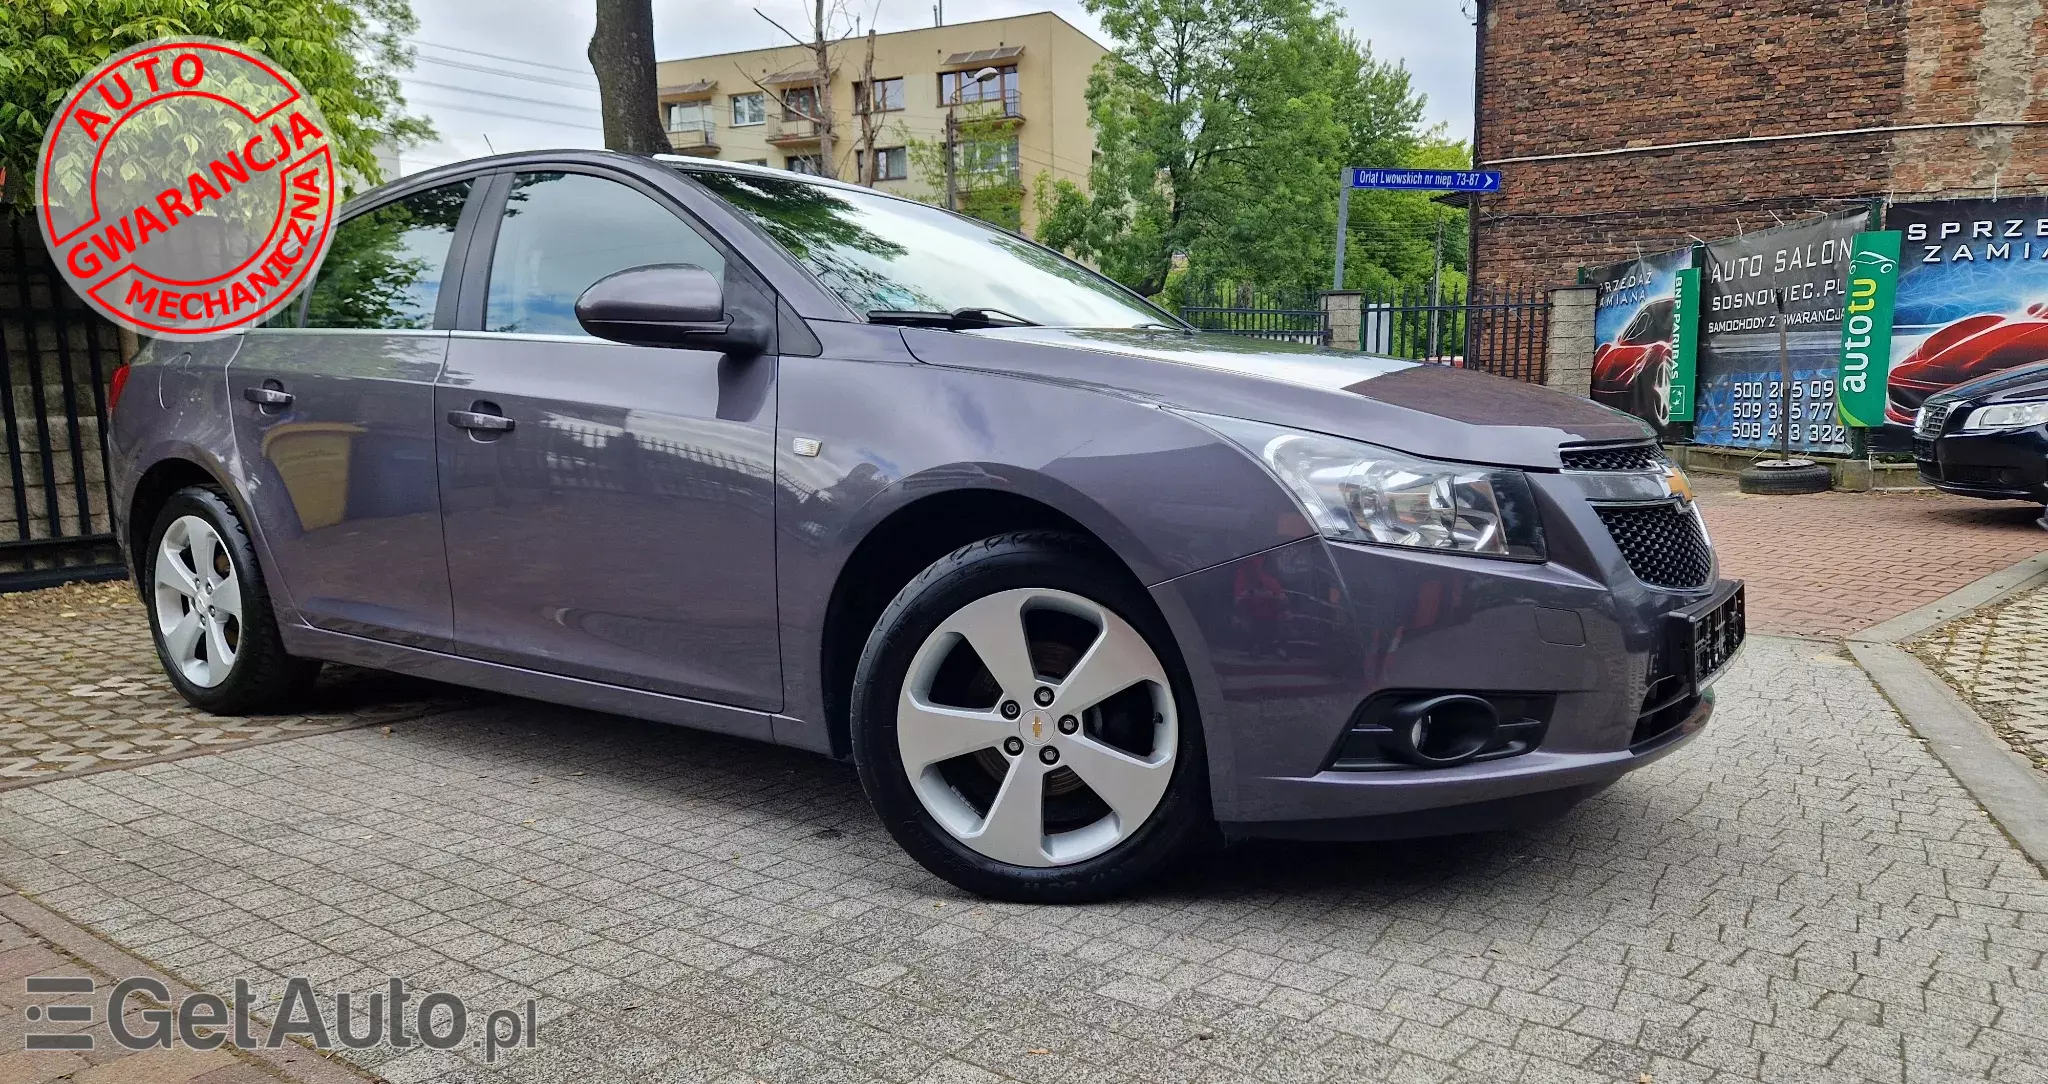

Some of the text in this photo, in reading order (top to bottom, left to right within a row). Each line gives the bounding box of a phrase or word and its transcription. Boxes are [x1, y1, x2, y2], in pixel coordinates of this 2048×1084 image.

[1380, 171, 1423, 185] Lwowskich
[1424, 174, 1434, 185] nr
[1435, 173, 1454, 188] niep.
[1456, 173, 1481, 186] 73-87
[1710, 236, 1853, 284] AUTO SALON
[1922, 242, 2048, 262] ZAMI
[1708, 316, 1767, 334] SAMOCHODY
[1768, 315, 1776, 328] Z
[1842, 278, 1877, 393] autotu
[1671, 313, 1681, 380] PARIBAS
[1734, 381, 1762, 398] 500
[1733, 402, 1762, 419] 509
[1768, 402, 1802, 420] 35
[1732, 422, 1761, 438] 508
[1808, 424, 1845, 442] 322
